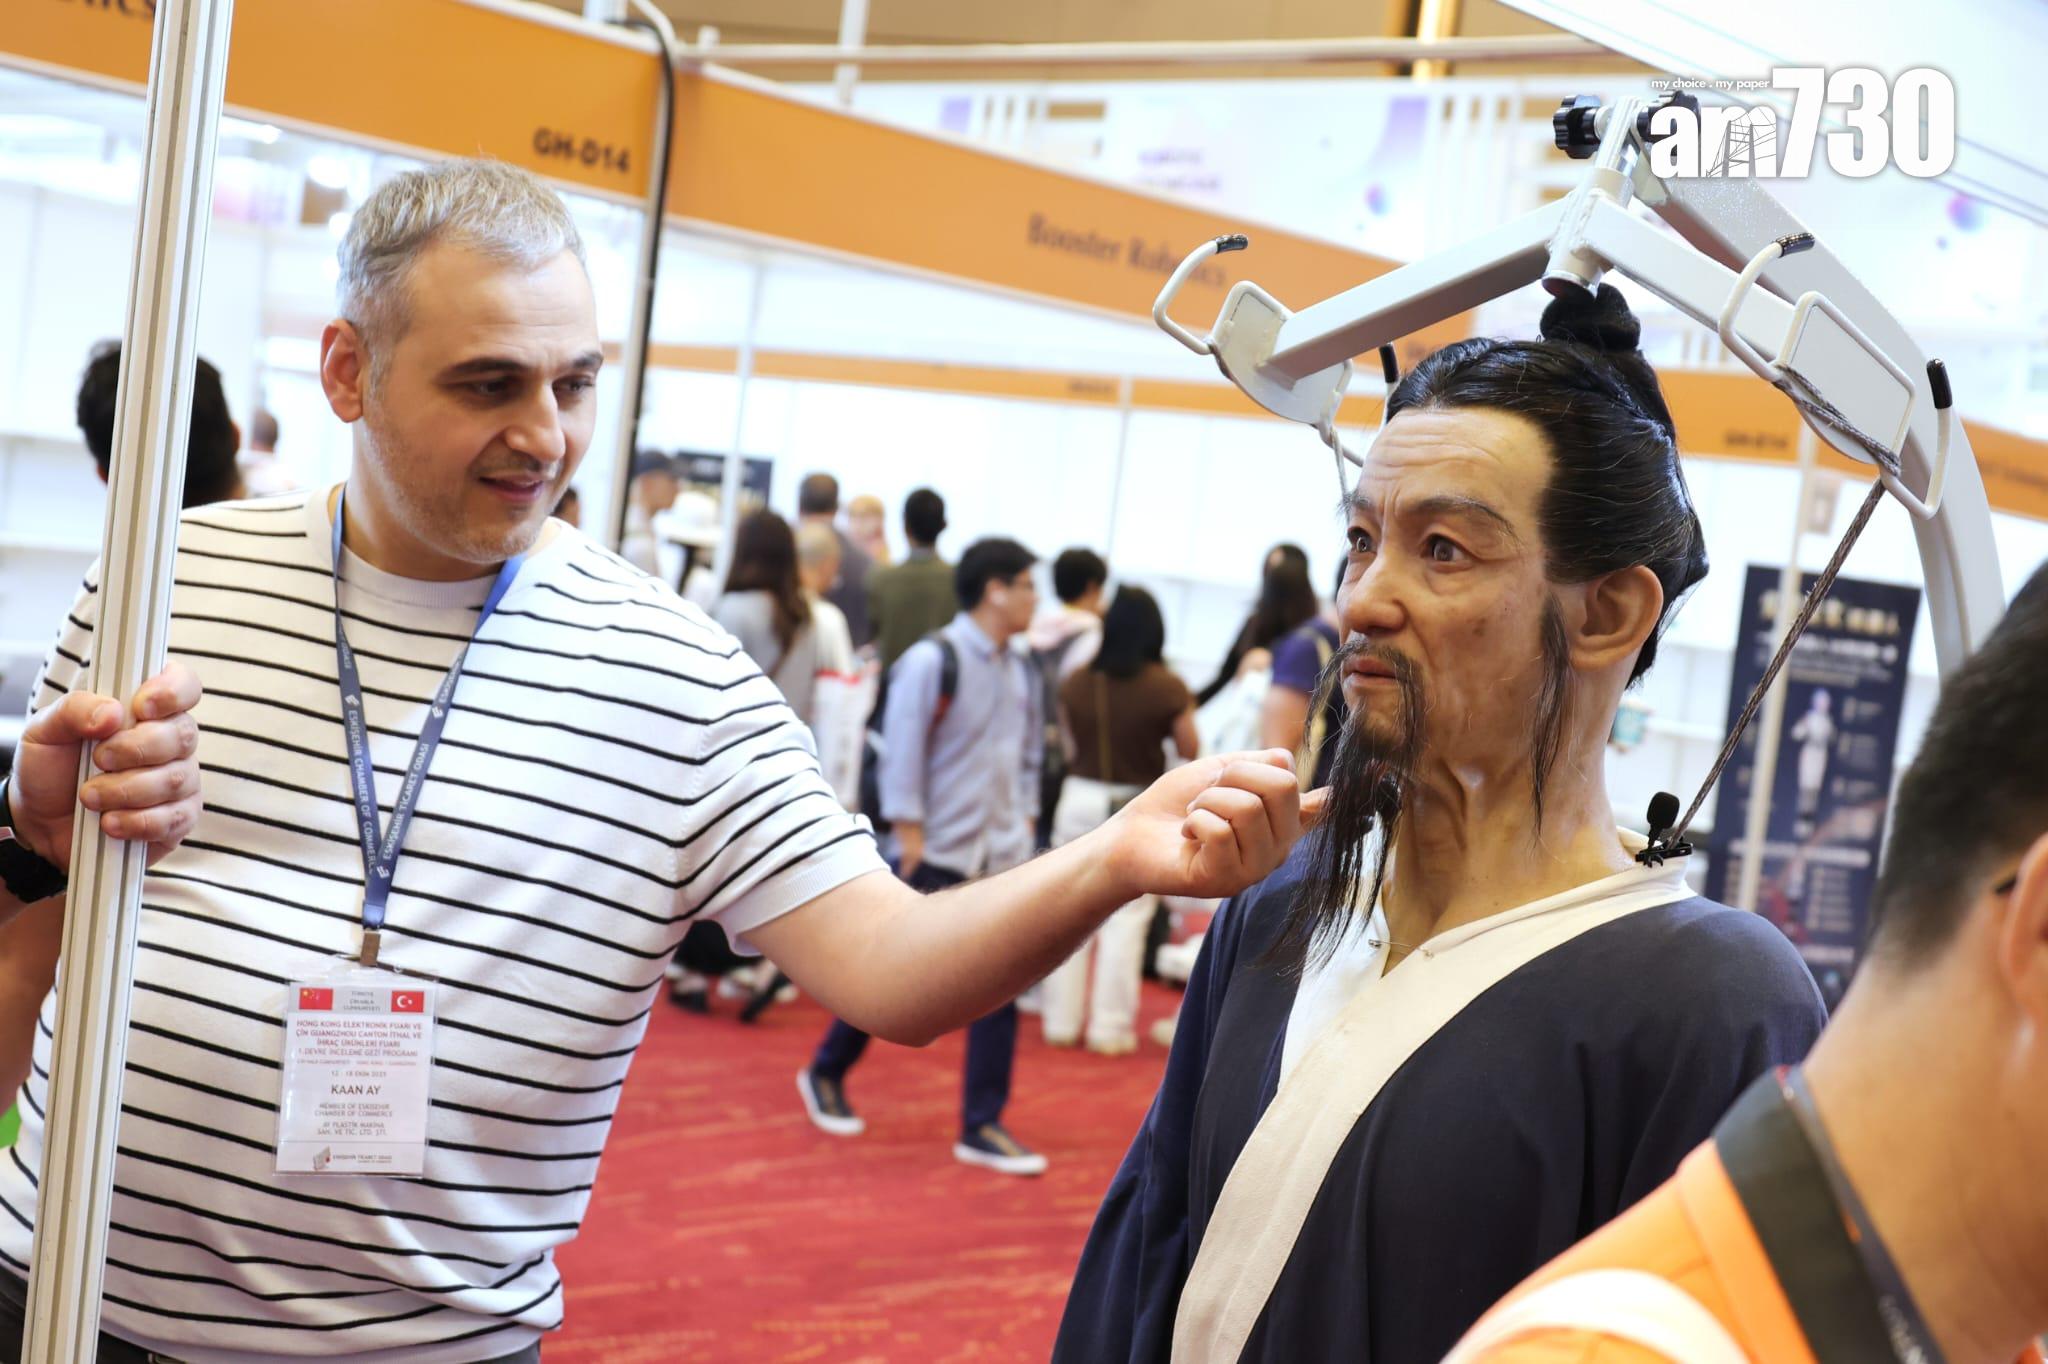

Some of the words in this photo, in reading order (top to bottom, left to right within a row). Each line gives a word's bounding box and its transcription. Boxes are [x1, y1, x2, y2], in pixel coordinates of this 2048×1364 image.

[532, 125, 630, 173] GH-D14
[1128, 236, 1227, 290] Robics
[354, 758, 369, 804] CHAMBER
[400, 772, 419, 810] TİCARET
[413, 743, 429, 770] ODASI
[360, 804, 372, 818] OF
[296, 1020, 319, 1028] HONG
[320, 1020, 342, 1029] KONG
[413, 1022, 422, 1030] VE
[358, 1030, 388, 1038] CANTON
[412, 1031, 422, 1039] VE
[331, 1084, 363, 1095] KAAN
[366, 1085, 381, 1095] AY
[347, 1102, 356, 1110] OF
